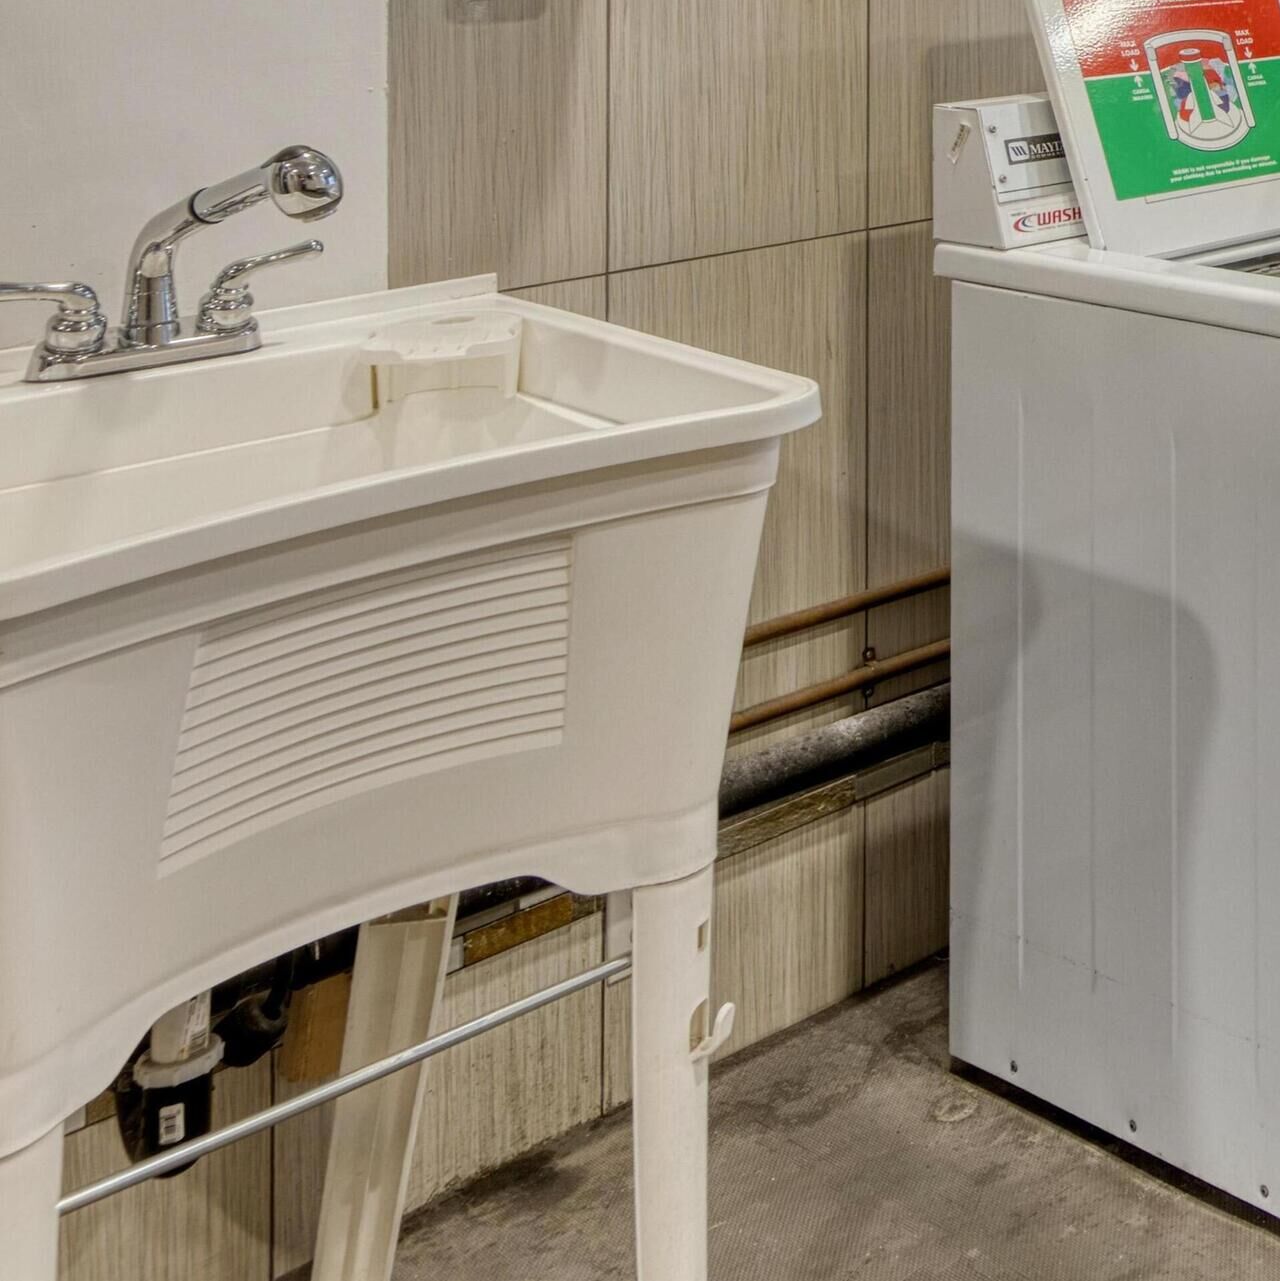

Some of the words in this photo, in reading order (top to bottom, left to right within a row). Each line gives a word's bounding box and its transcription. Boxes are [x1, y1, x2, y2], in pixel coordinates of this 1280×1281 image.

[1235, 29, 1250, 37] MAX
[1120, 40, 1136, 48] MAX
[1236, 37, 1254, 45] LOAD
[1121, 49, 1140, 57] LOAD
[1029, 140, 1063, 155] MAYT
[1037, 206, 1082, 226] WASH
